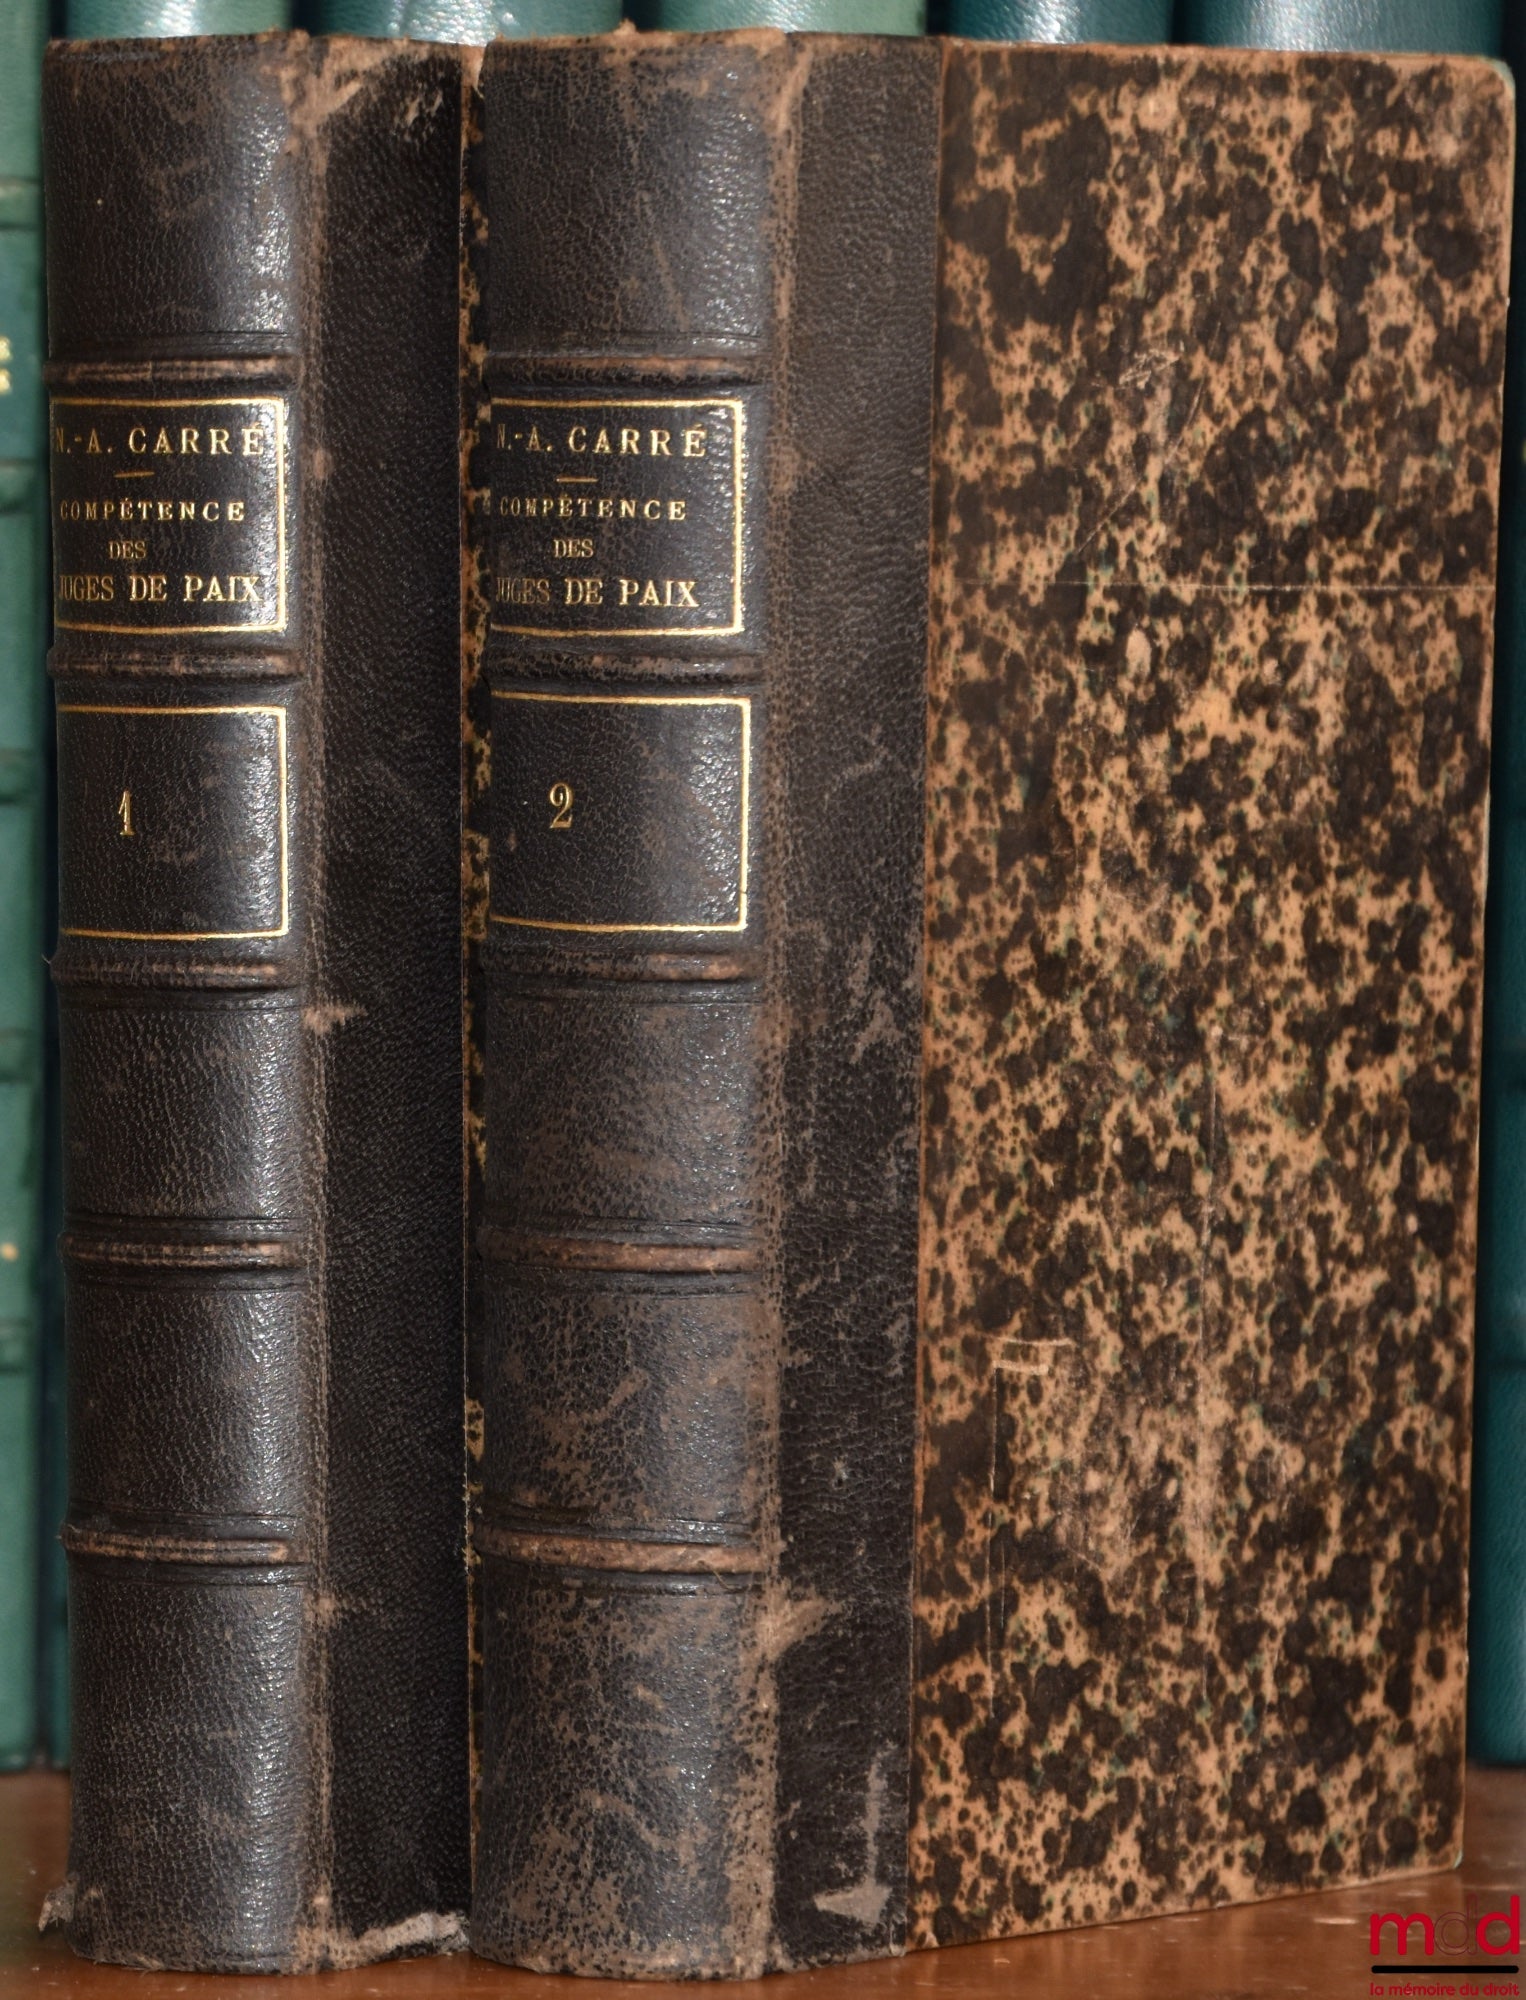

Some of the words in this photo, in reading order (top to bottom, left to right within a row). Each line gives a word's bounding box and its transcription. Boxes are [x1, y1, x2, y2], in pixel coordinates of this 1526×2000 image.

[129, 421, 264, 456] CARRÉ
[568, 423, 707, 457] CARRÉ
[60, 498, 245, 521] COMPÉTENCE
[500, 493, 687, 520] COMPÉTENCE
[108, 540, 147, 560] DES
[553, 539, 594, 558] DES
[129, 574, 168, 602] DE
[183, 574, 264, 603] PAIX
[564, 577, 603, 606] DE
[619, 577, 700, 607] PAIX
[118, 788, 136, 836] 1
[548, 782, 574, 829] 2
